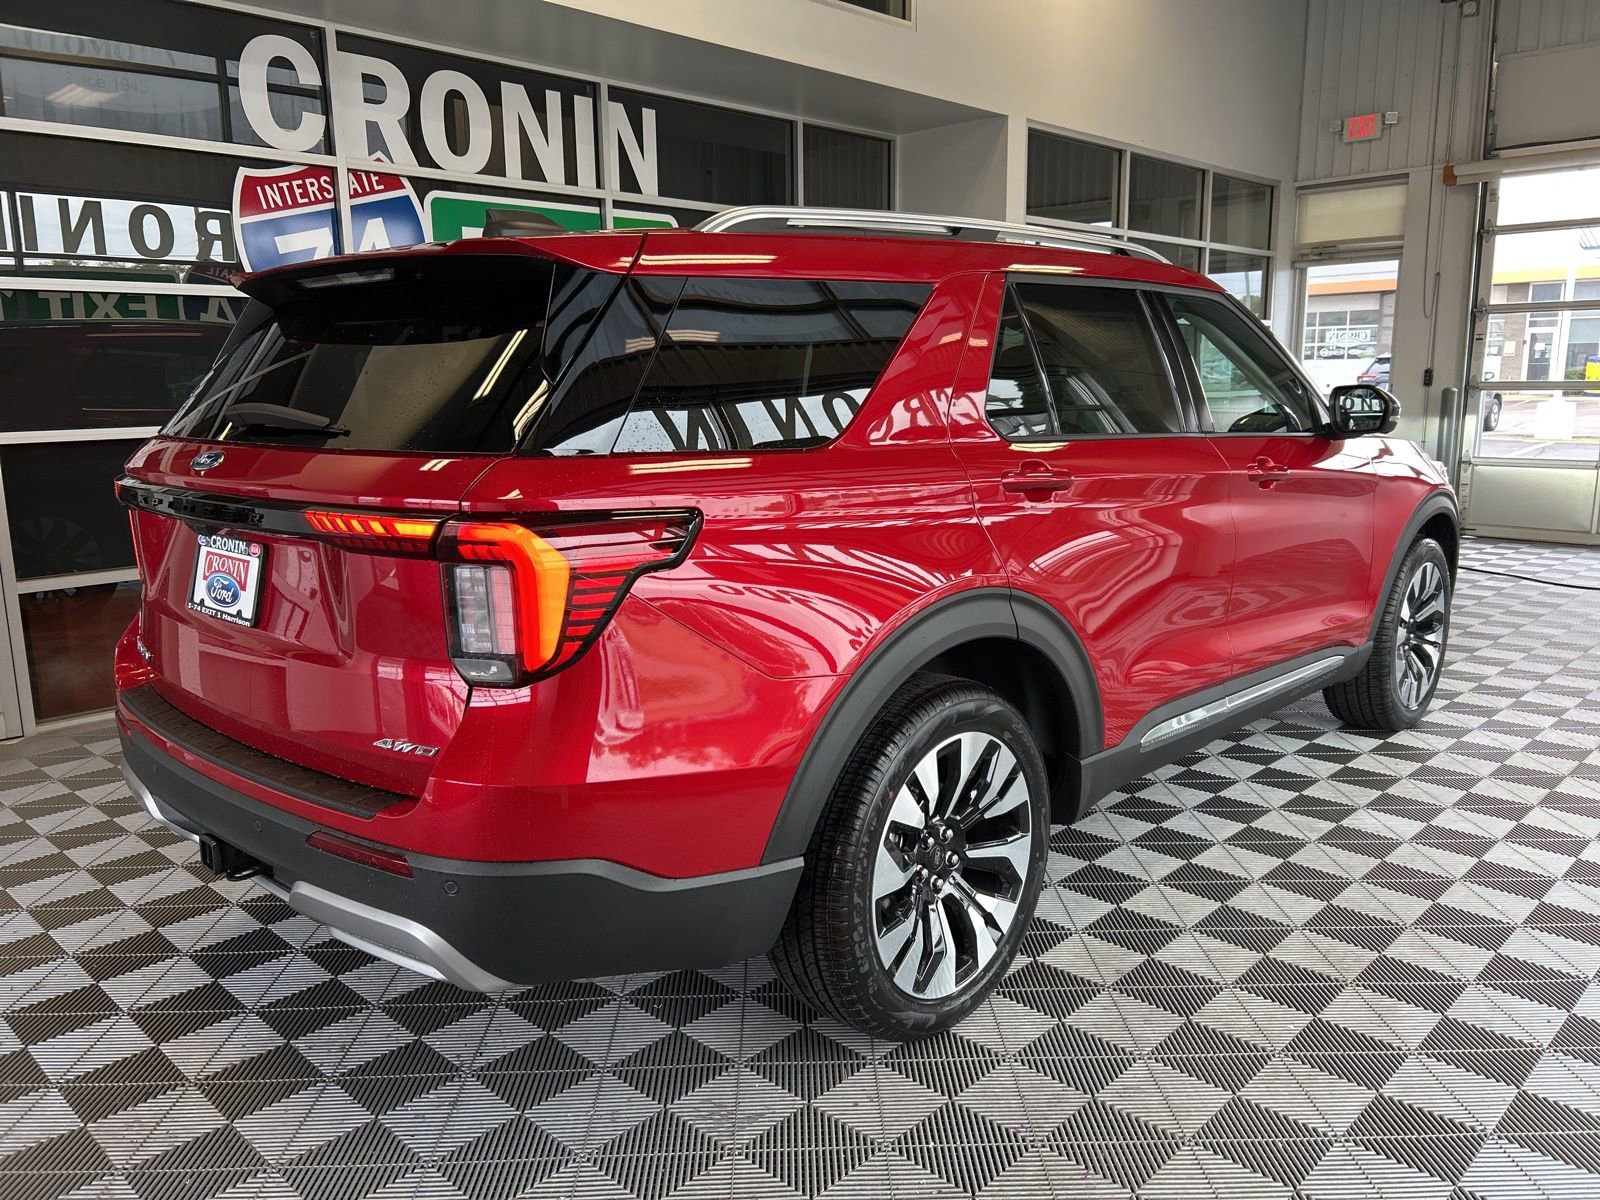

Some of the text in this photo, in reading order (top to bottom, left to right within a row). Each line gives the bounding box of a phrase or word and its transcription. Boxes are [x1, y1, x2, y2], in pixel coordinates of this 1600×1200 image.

[238, 34, 659, 196] CRONIN
[1348, 114, 1377, 138] EXIT
[256, 170, 384, 210] INTERSATE
[211, 535, 246, 554] CRONIN
[205, 554, 248, 585] CRONIN
[211, 577, 235, 603] Ford
[188, 602, 201, 612] I-74
[202, 606, 217, 617] EXIT
[222, 613, 250, 628] Harrison
[373, 738, 439, 757] 4WD
